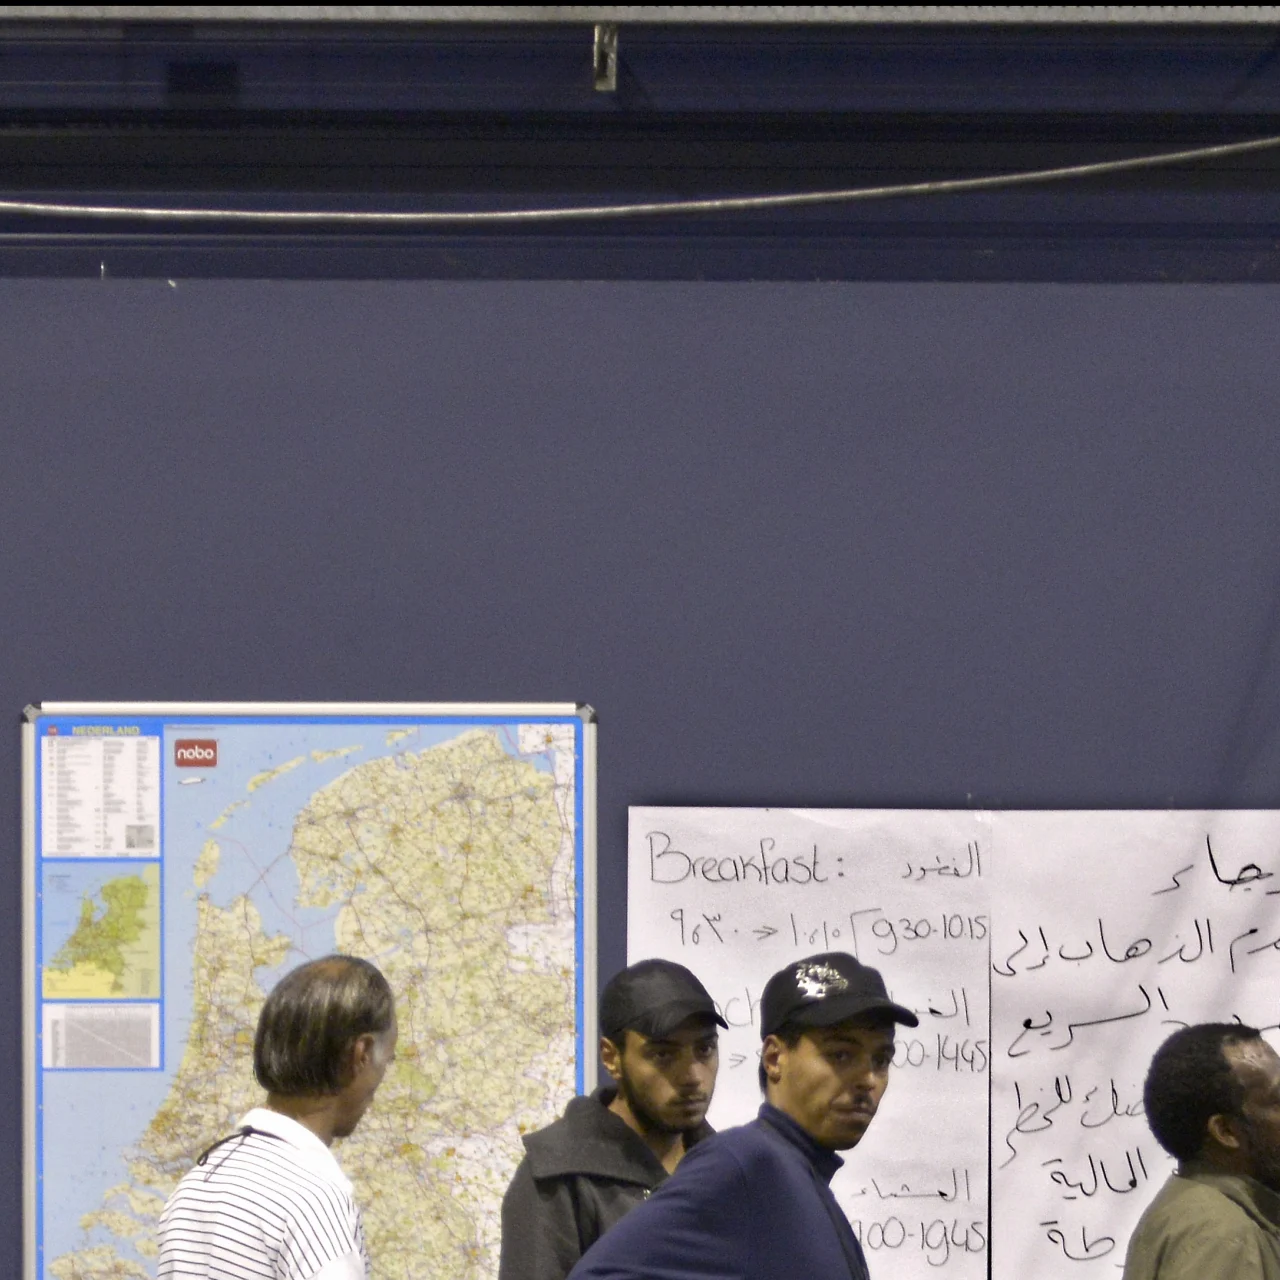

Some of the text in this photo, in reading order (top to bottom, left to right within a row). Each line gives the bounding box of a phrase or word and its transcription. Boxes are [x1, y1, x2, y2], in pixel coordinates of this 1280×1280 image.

[73, 726, 140, 736] NEDERLAND
[177, 745, 215, 760] nobo
[992, 925, 1051, 978] إلى
[1058, 917, 1214, 964] الذهاب
[1007, 983, 1170, 1059] السريع
